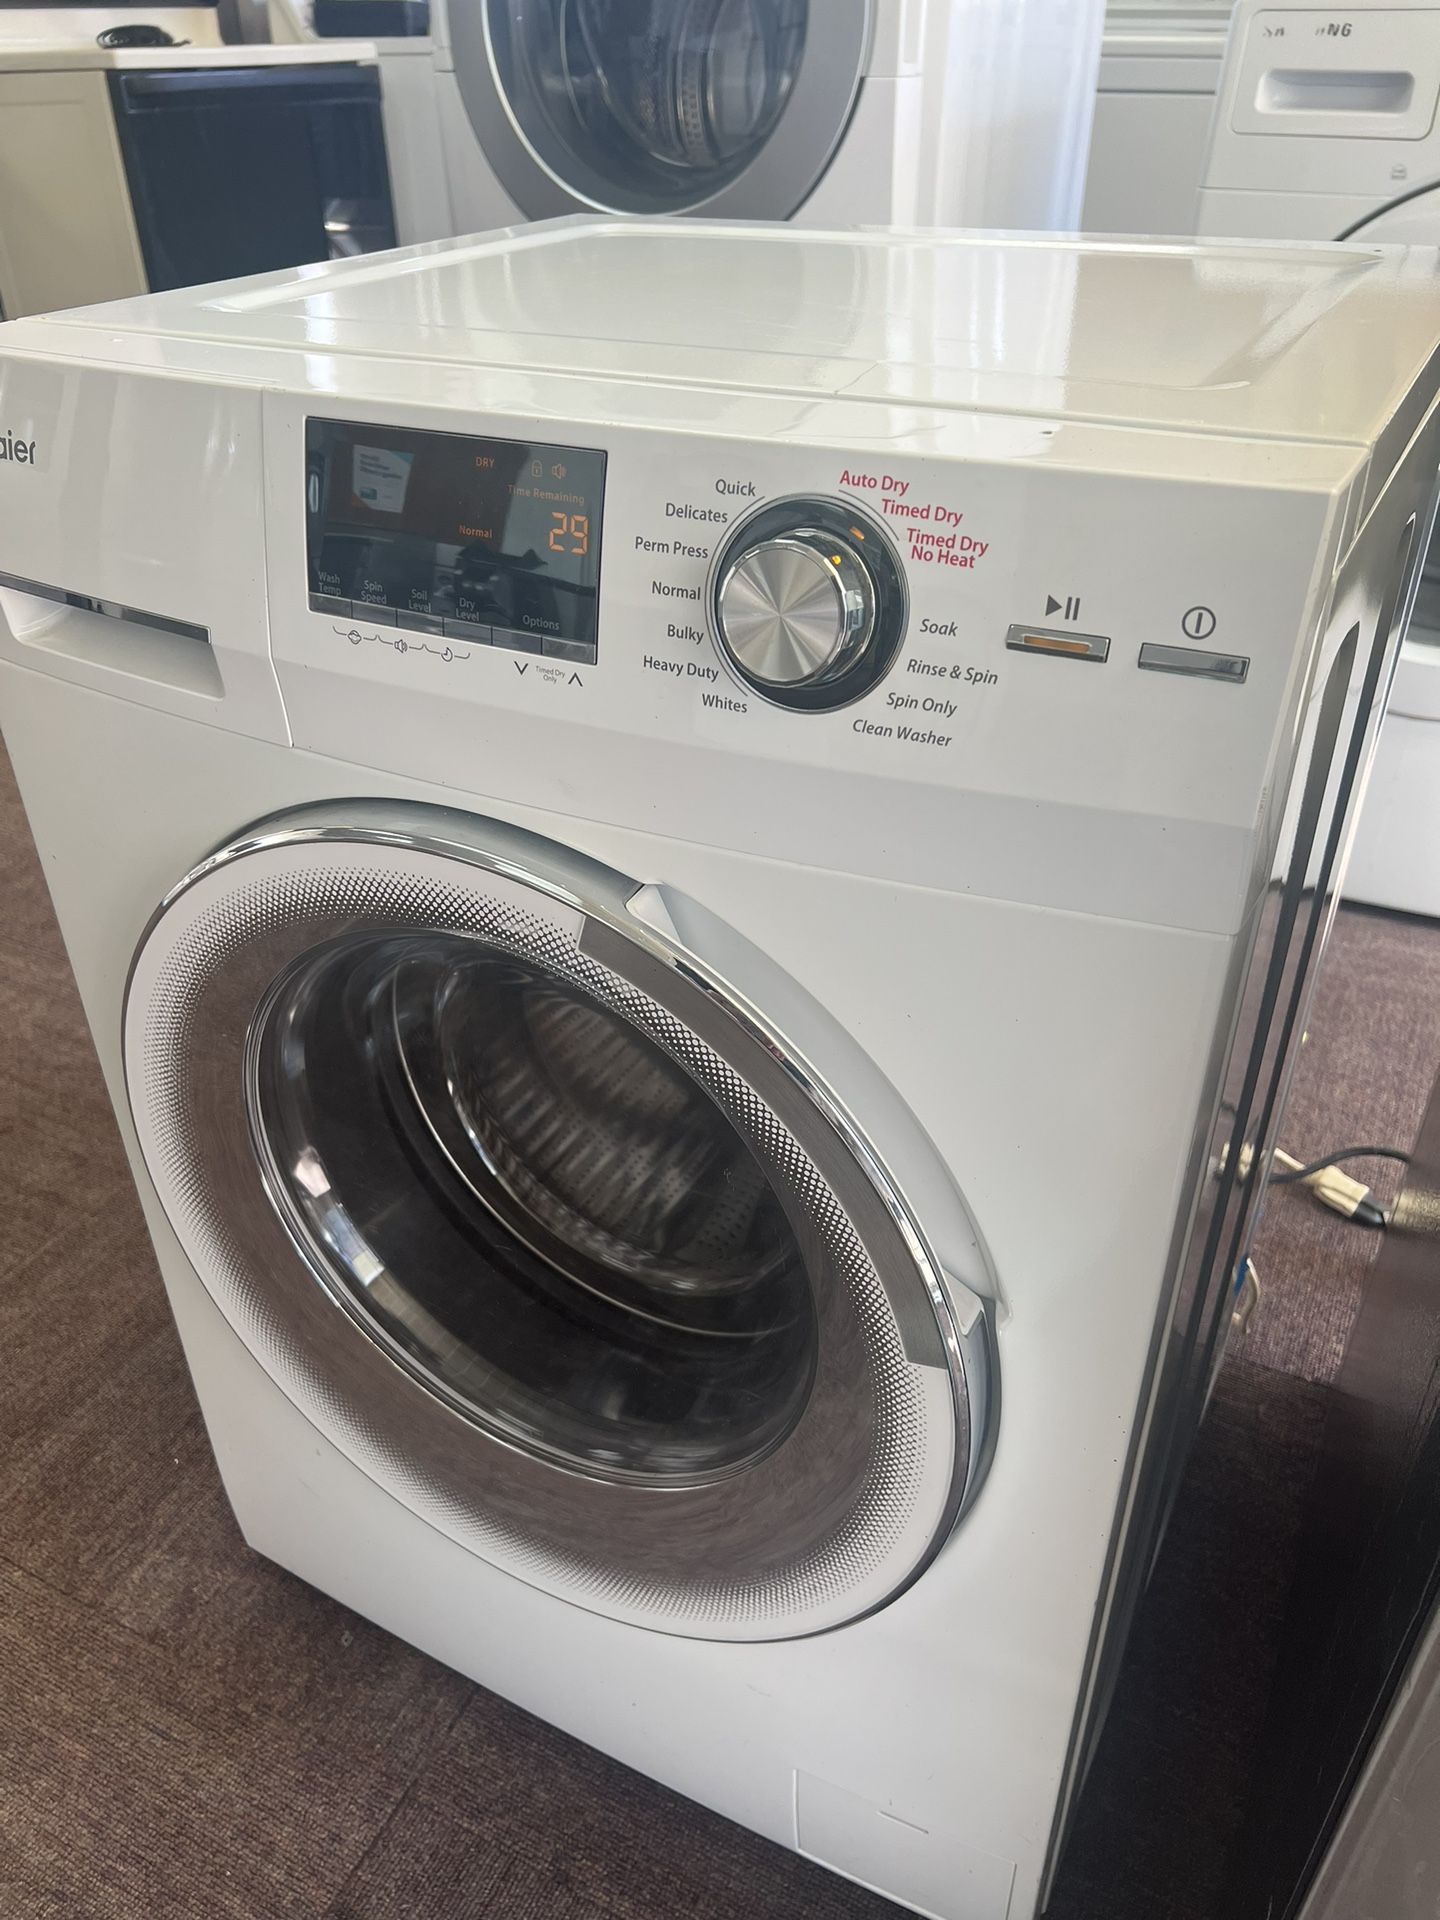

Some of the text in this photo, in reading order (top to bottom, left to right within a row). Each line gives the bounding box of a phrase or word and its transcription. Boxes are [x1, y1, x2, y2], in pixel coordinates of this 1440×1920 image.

[476, 456, 495, 468] DRY
[715, 479, 756, 497] Quick
[840, 470, 910, 496] Auto Dry
[508, 484, 585, 506] Time Remaining
[665, 502, 728, 524] Delicates
[882, 498, 963, 527] Timed Dry
[458, 524, 492, 538] Normal
[550, 512, 588, 555] 29
[635, 537, 708, 559] Perm Press
[906, 528, 989, 557] Timed Dry
[910, 546, 976, 568] No Heat
[318, 572, 340, 584] Wash
[364, 580, 382, 592] Spin
[318, 582, 342, 597] Temp
[361, 591, 386, 604] Speed
[412, 588, 428, 600] Soil
[651, 581, 701, 600] Normal
[408, 600, 432, 613] Level
[459, 598, 476, 612] Dry
[456, 608, 480, 622] Level
[522, 614, 560, 631] Options
[667, 624, 704, 644] Bulky
[920, 618, 958, 637] Soak
[536, 666, 566, 678] Timed Dry
[643, 656, 719, 682] Heavy Duty
[907, 658, 998, 686] Rinse & Spin
[543, 674, 558, 684] Only
[702, 694, 748, 714] Whites
[886, 692, 958, 718] Spin Only
[852, 719, 952, 747] Clean Washer
